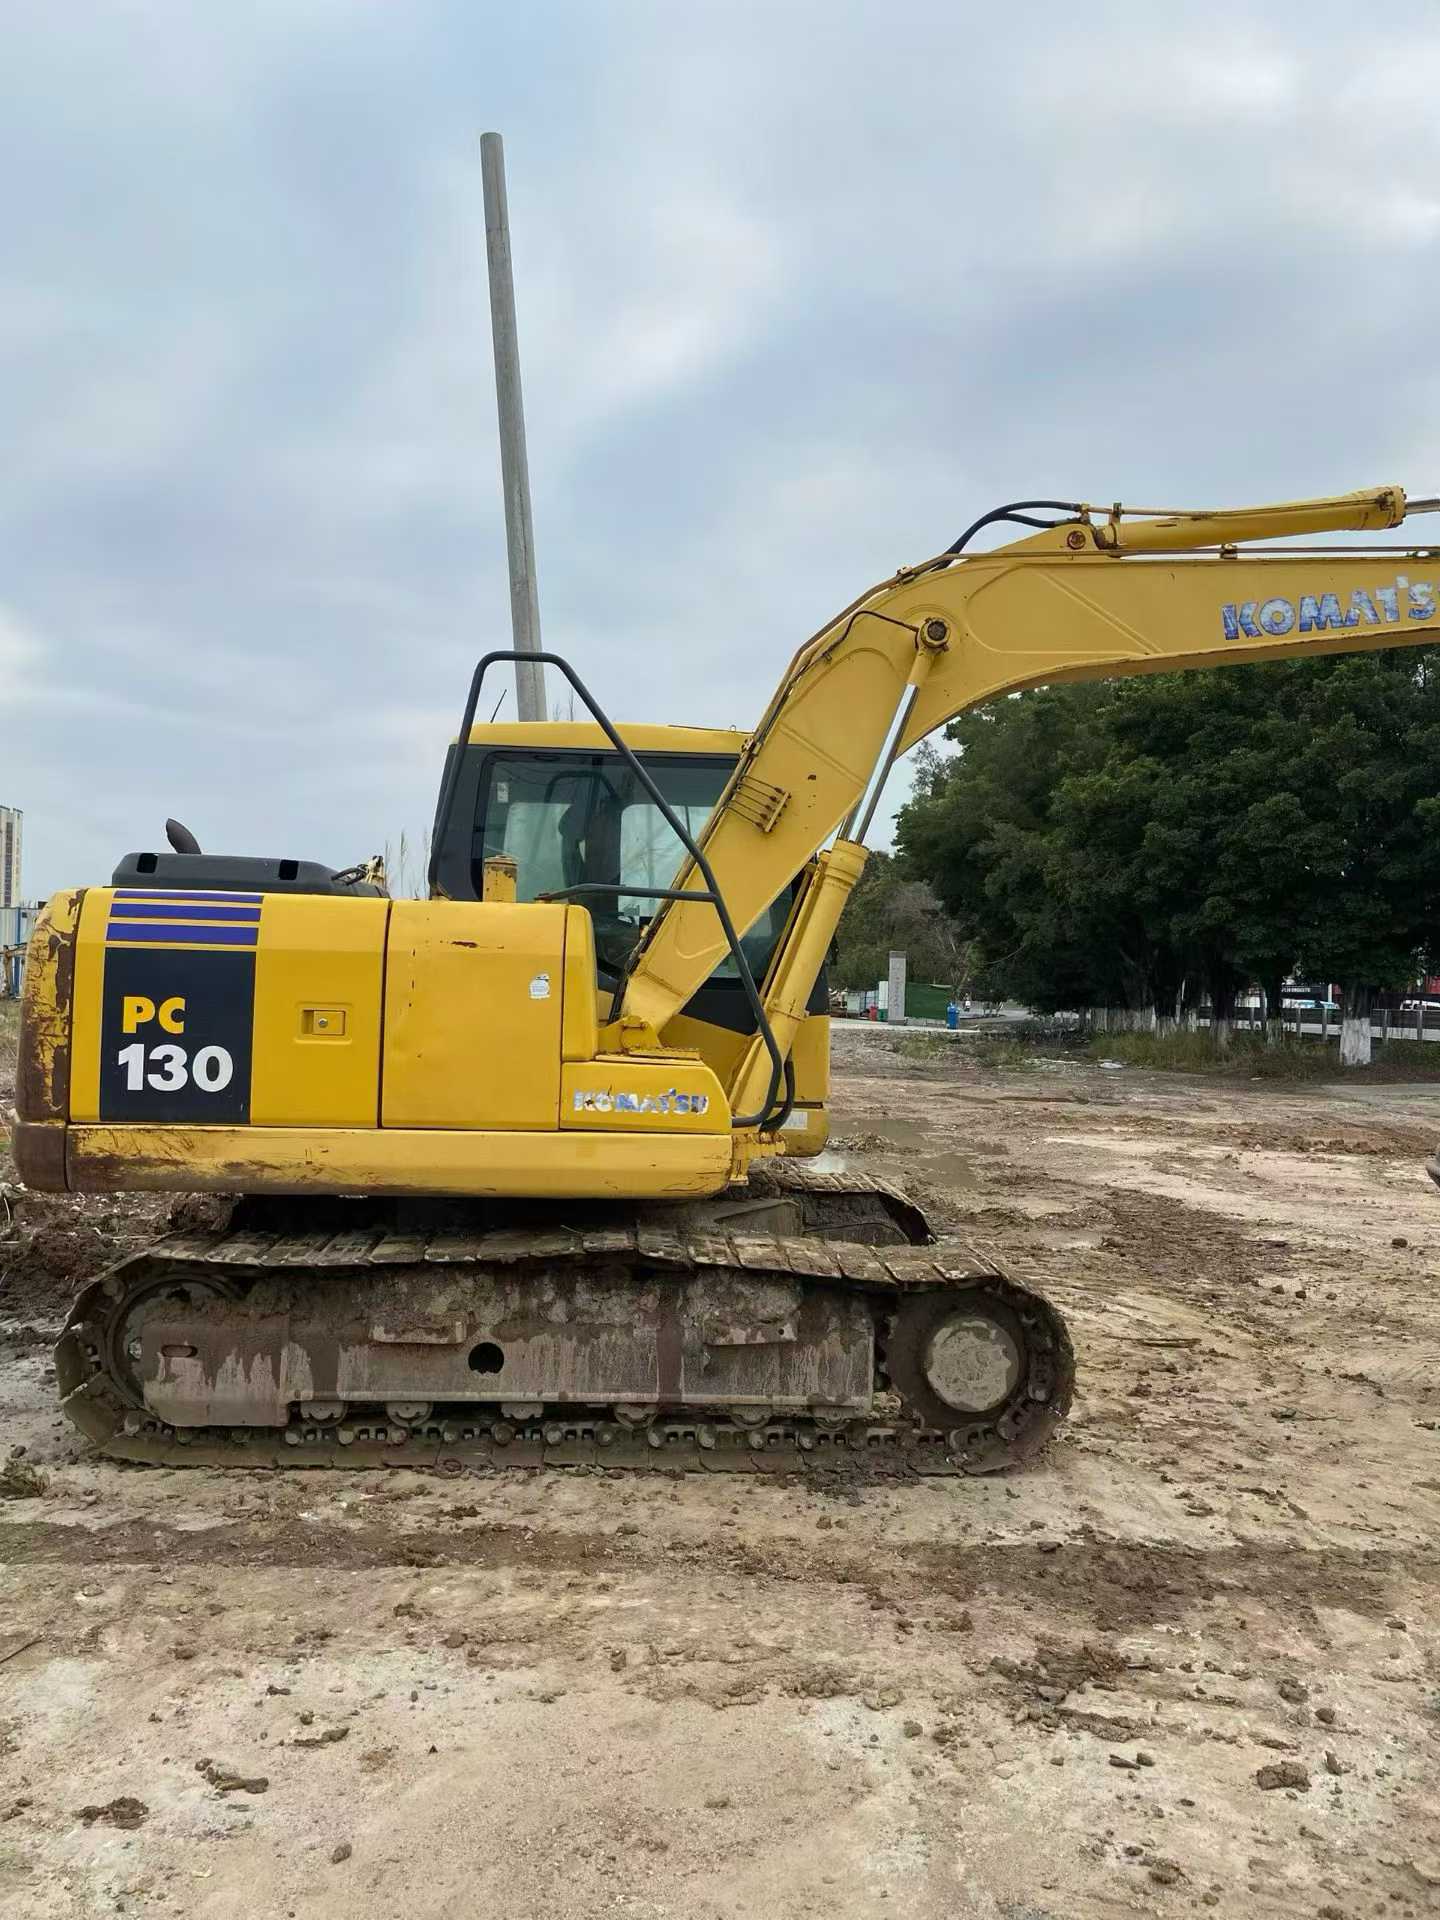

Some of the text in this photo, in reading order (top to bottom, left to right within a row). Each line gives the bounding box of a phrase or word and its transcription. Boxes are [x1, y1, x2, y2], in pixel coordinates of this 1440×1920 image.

[1221, 575, 1440, 640] KOMATS
[122, 996, 186, 1035] PC
[117, 1043, 234, 1093] 130
